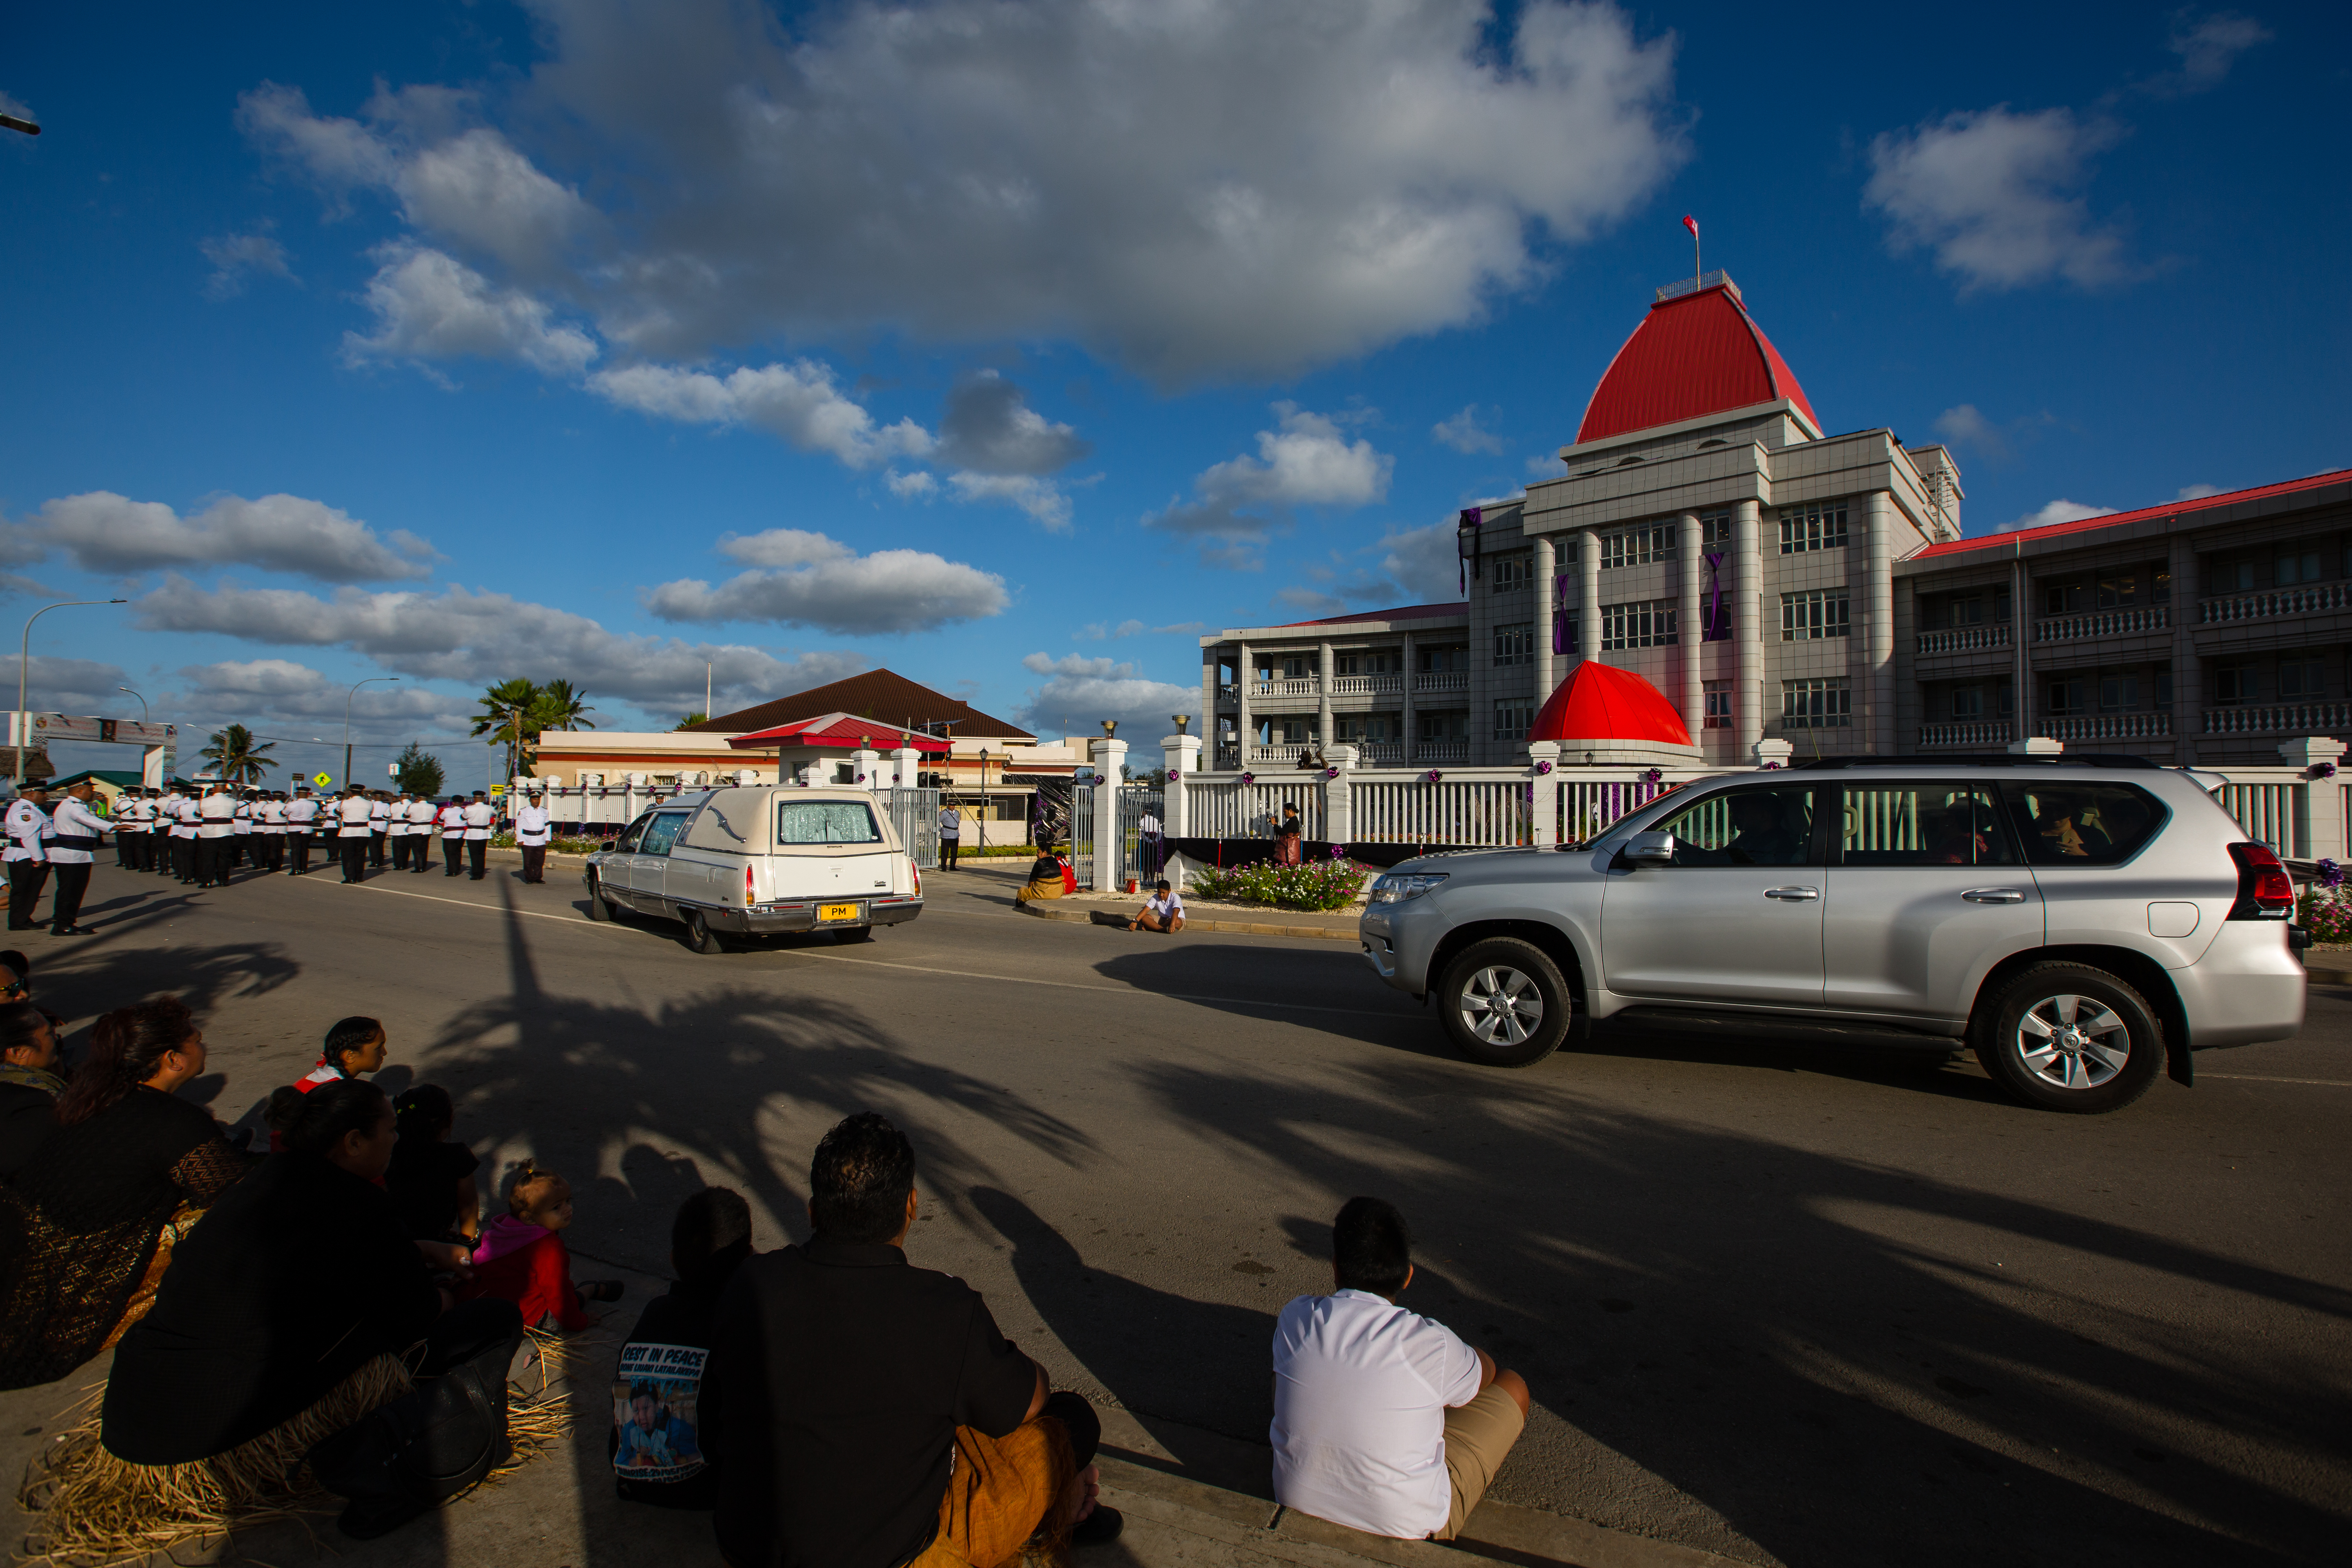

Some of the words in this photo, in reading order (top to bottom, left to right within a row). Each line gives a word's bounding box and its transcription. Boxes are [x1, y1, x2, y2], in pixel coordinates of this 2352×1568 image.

[832, 907, 846, 916] PM
[623, 1347, 649, 1361] REST
[648, 1348, 664, 1362] IN
[664, 1349, 705, 1366] PEACE
[655, 1365, 700, 1377] LATAILAKEPA
